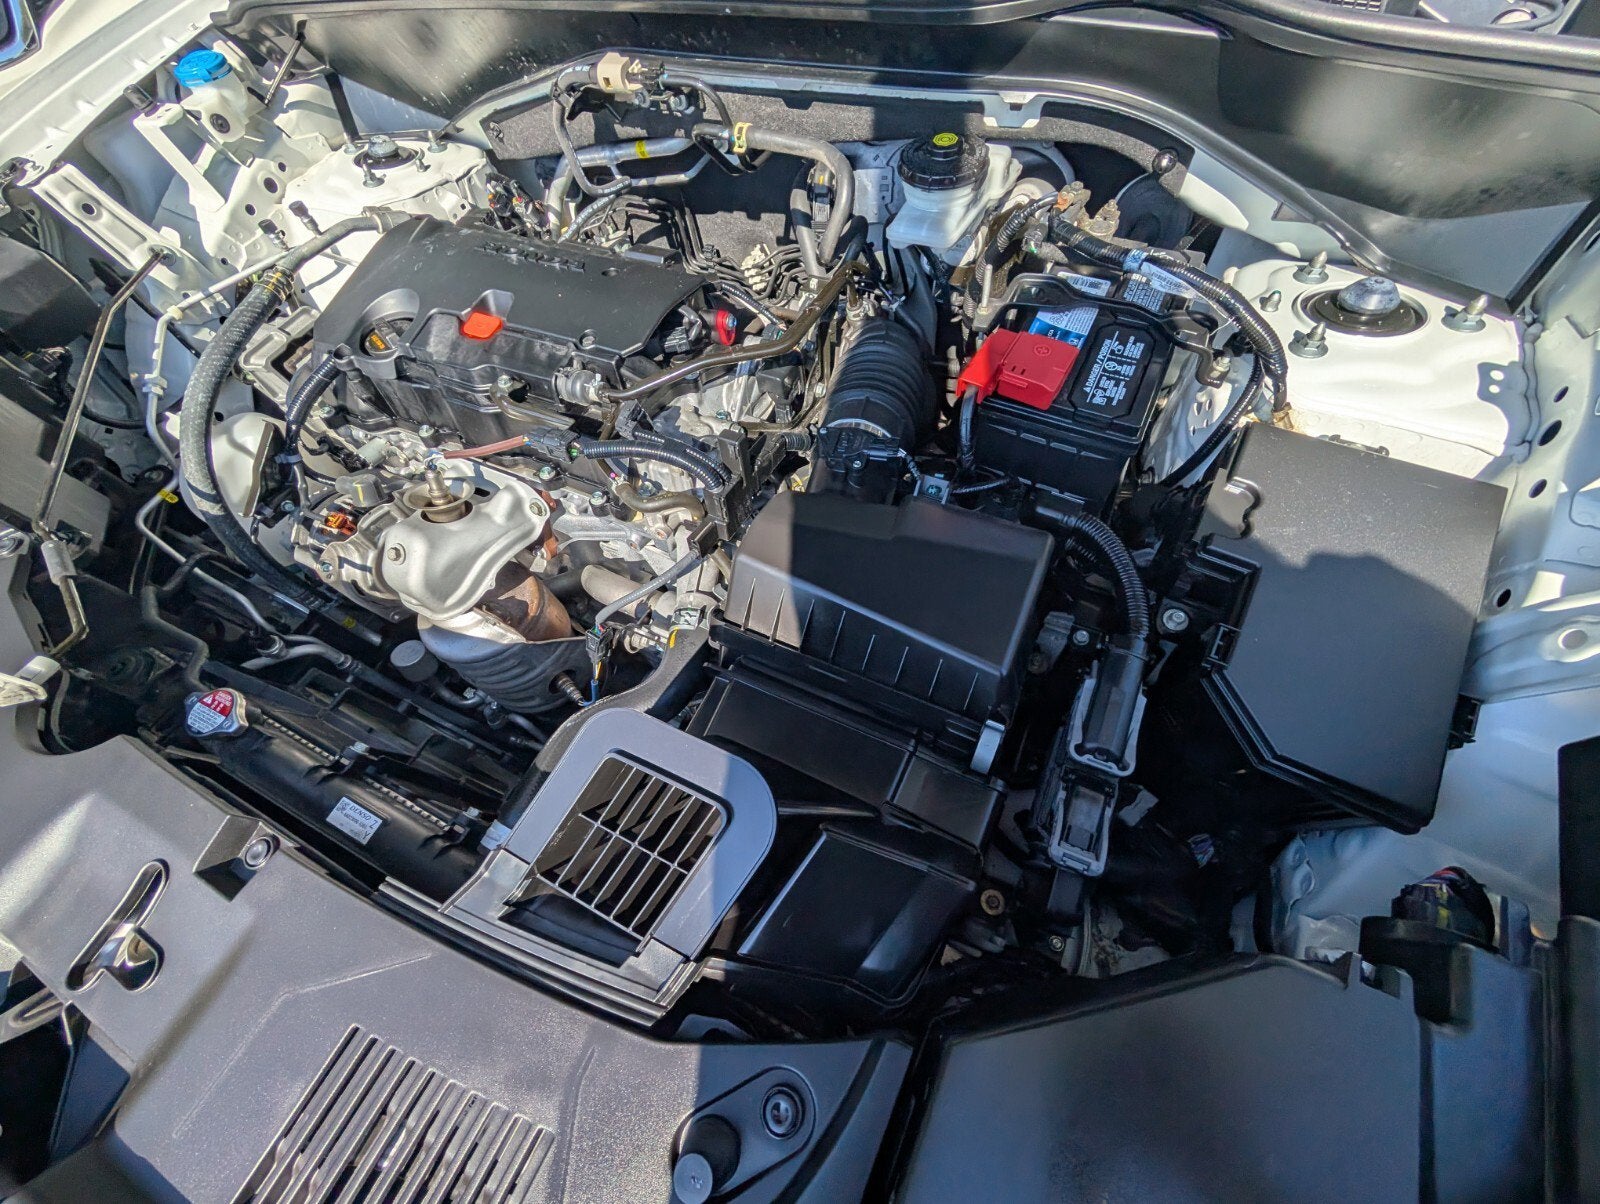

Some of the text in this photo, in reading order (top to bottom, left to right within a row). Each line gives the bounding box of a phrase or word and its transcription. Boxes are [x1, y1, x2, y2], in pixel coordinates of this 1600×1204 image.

[1085, 363, 1102, 387] DANGER
[1098, 339, 1112, 360] POISON
[349, 804, 372, 821] DENSO
